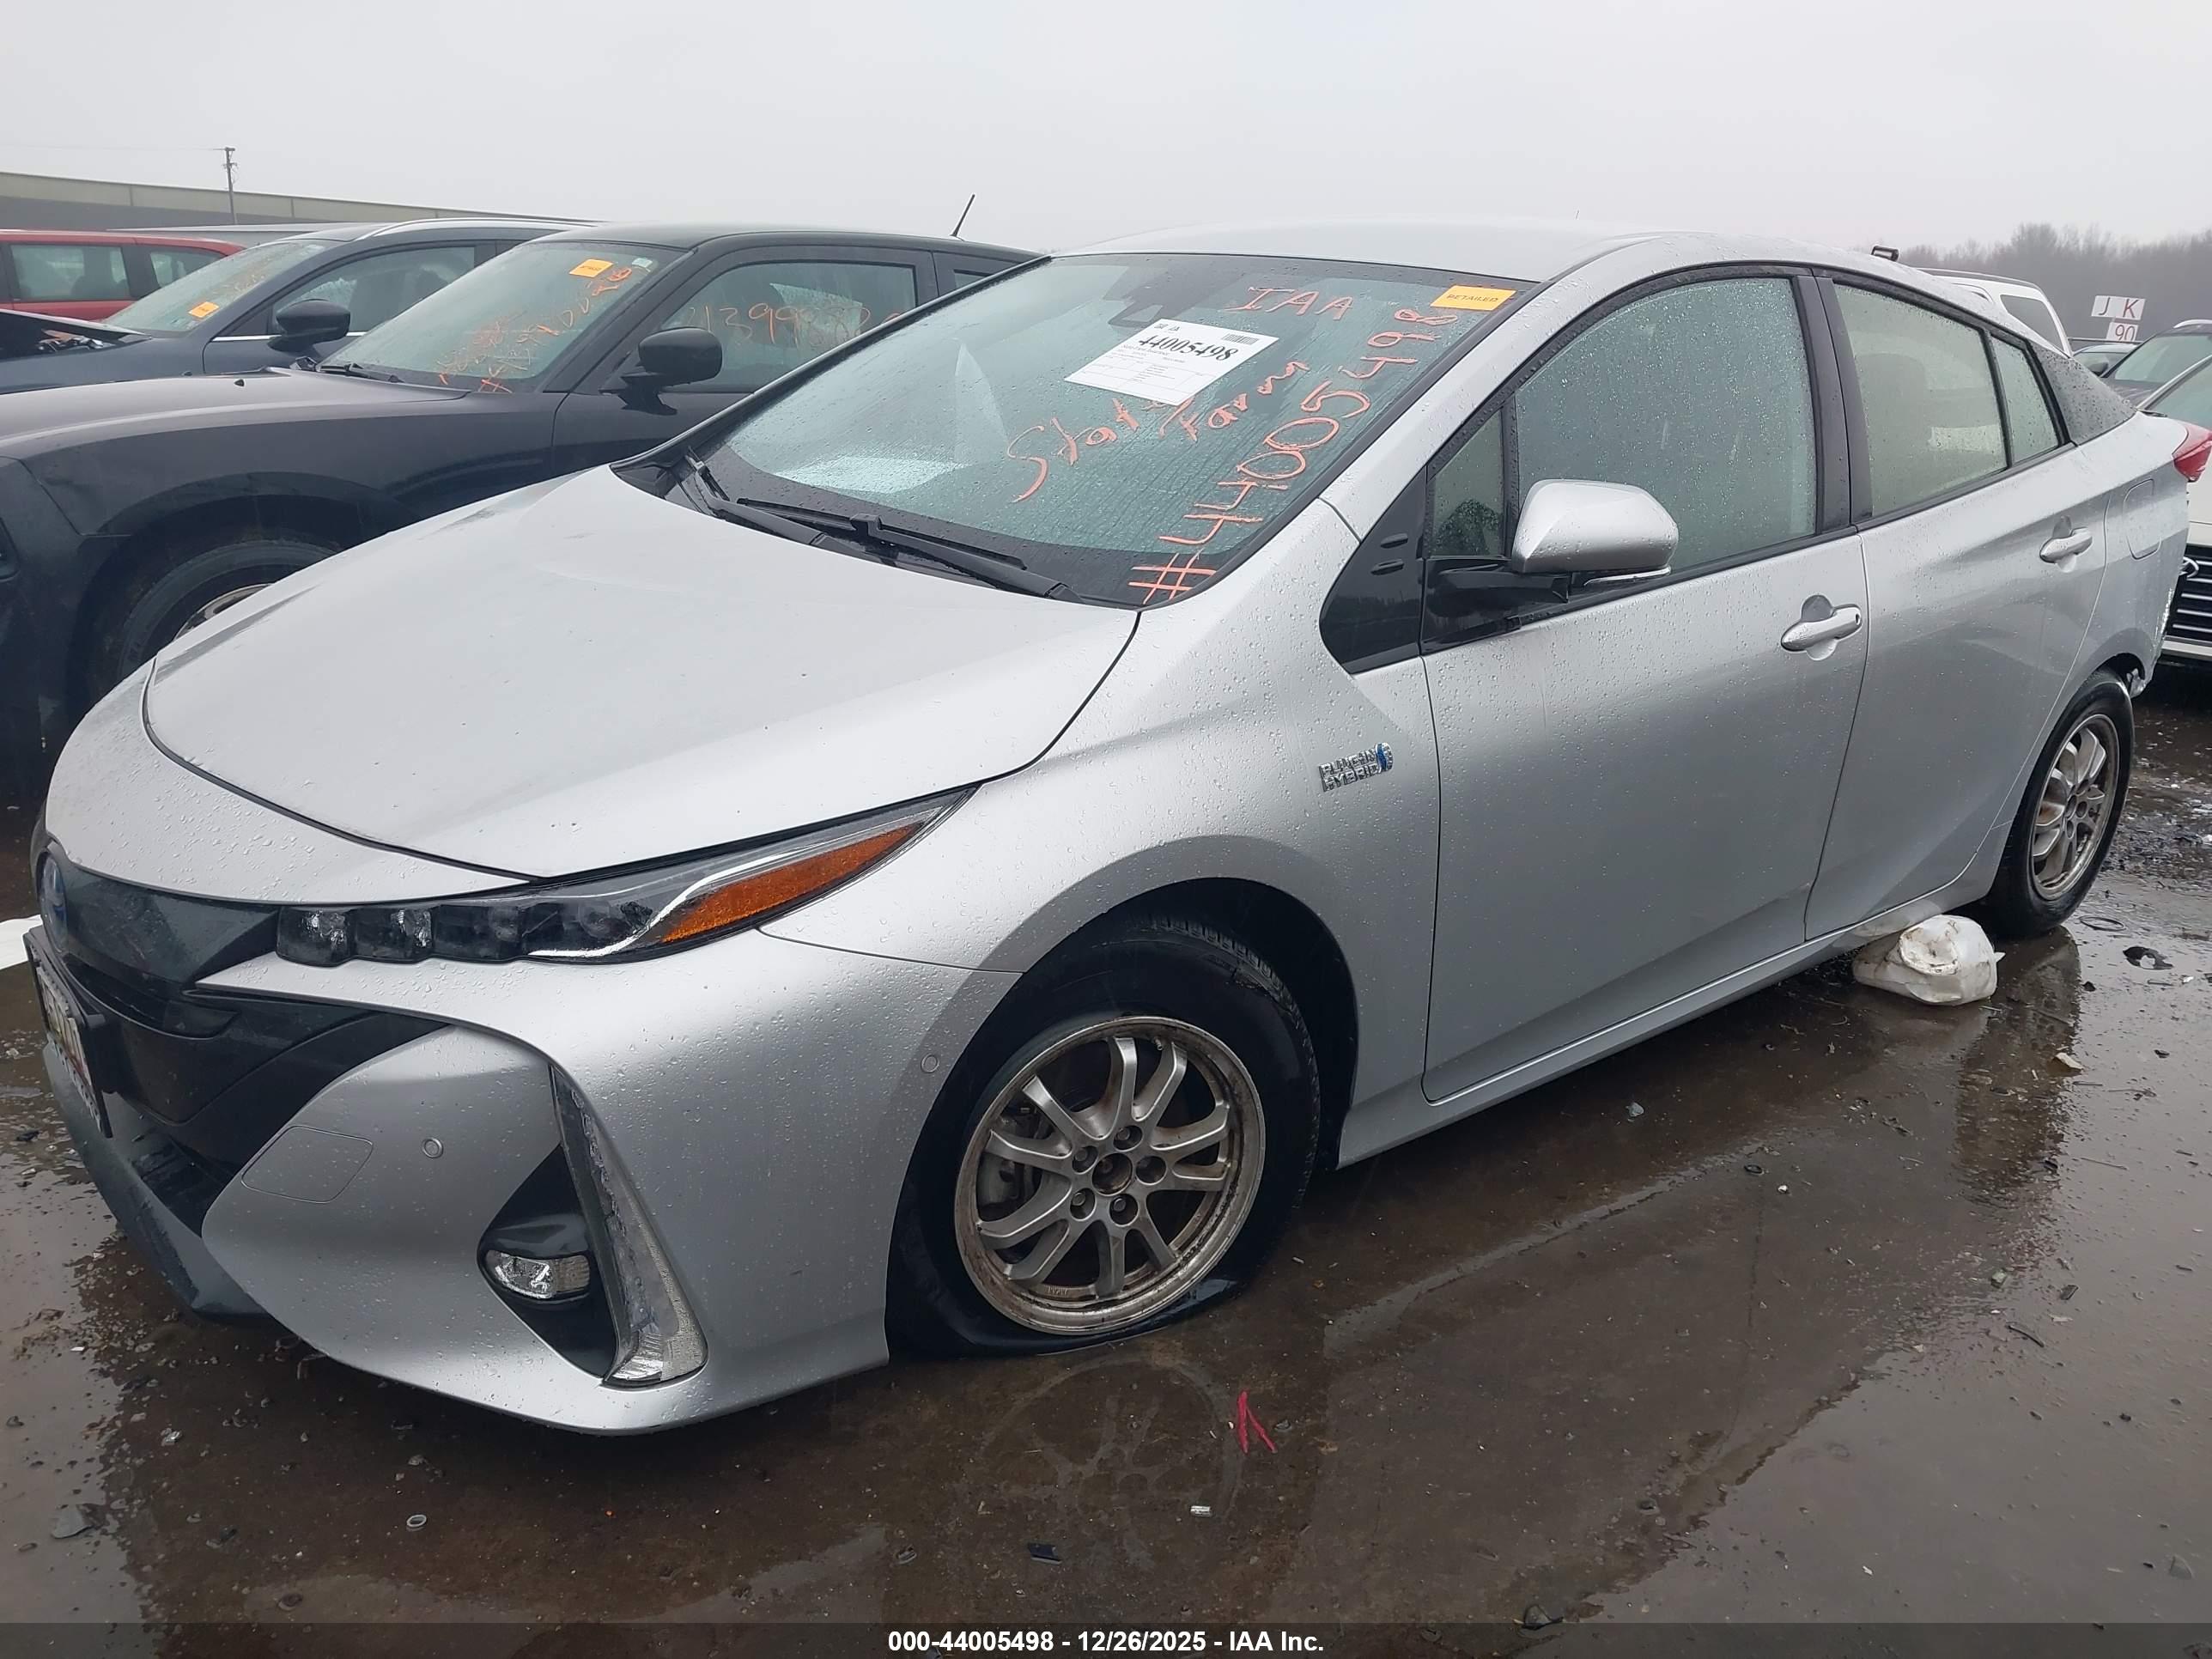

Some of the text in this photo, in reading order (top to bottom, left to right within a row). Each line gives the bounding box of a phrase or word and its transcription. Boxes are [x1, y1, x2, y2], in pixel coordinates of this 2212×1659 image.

[1224, 286, 1353, 321] IAA
[2098, 296, 2140, 319] J K
[2115, 324, 2136, 341] 90
[1138, 334, 1238, 362] 44005498
